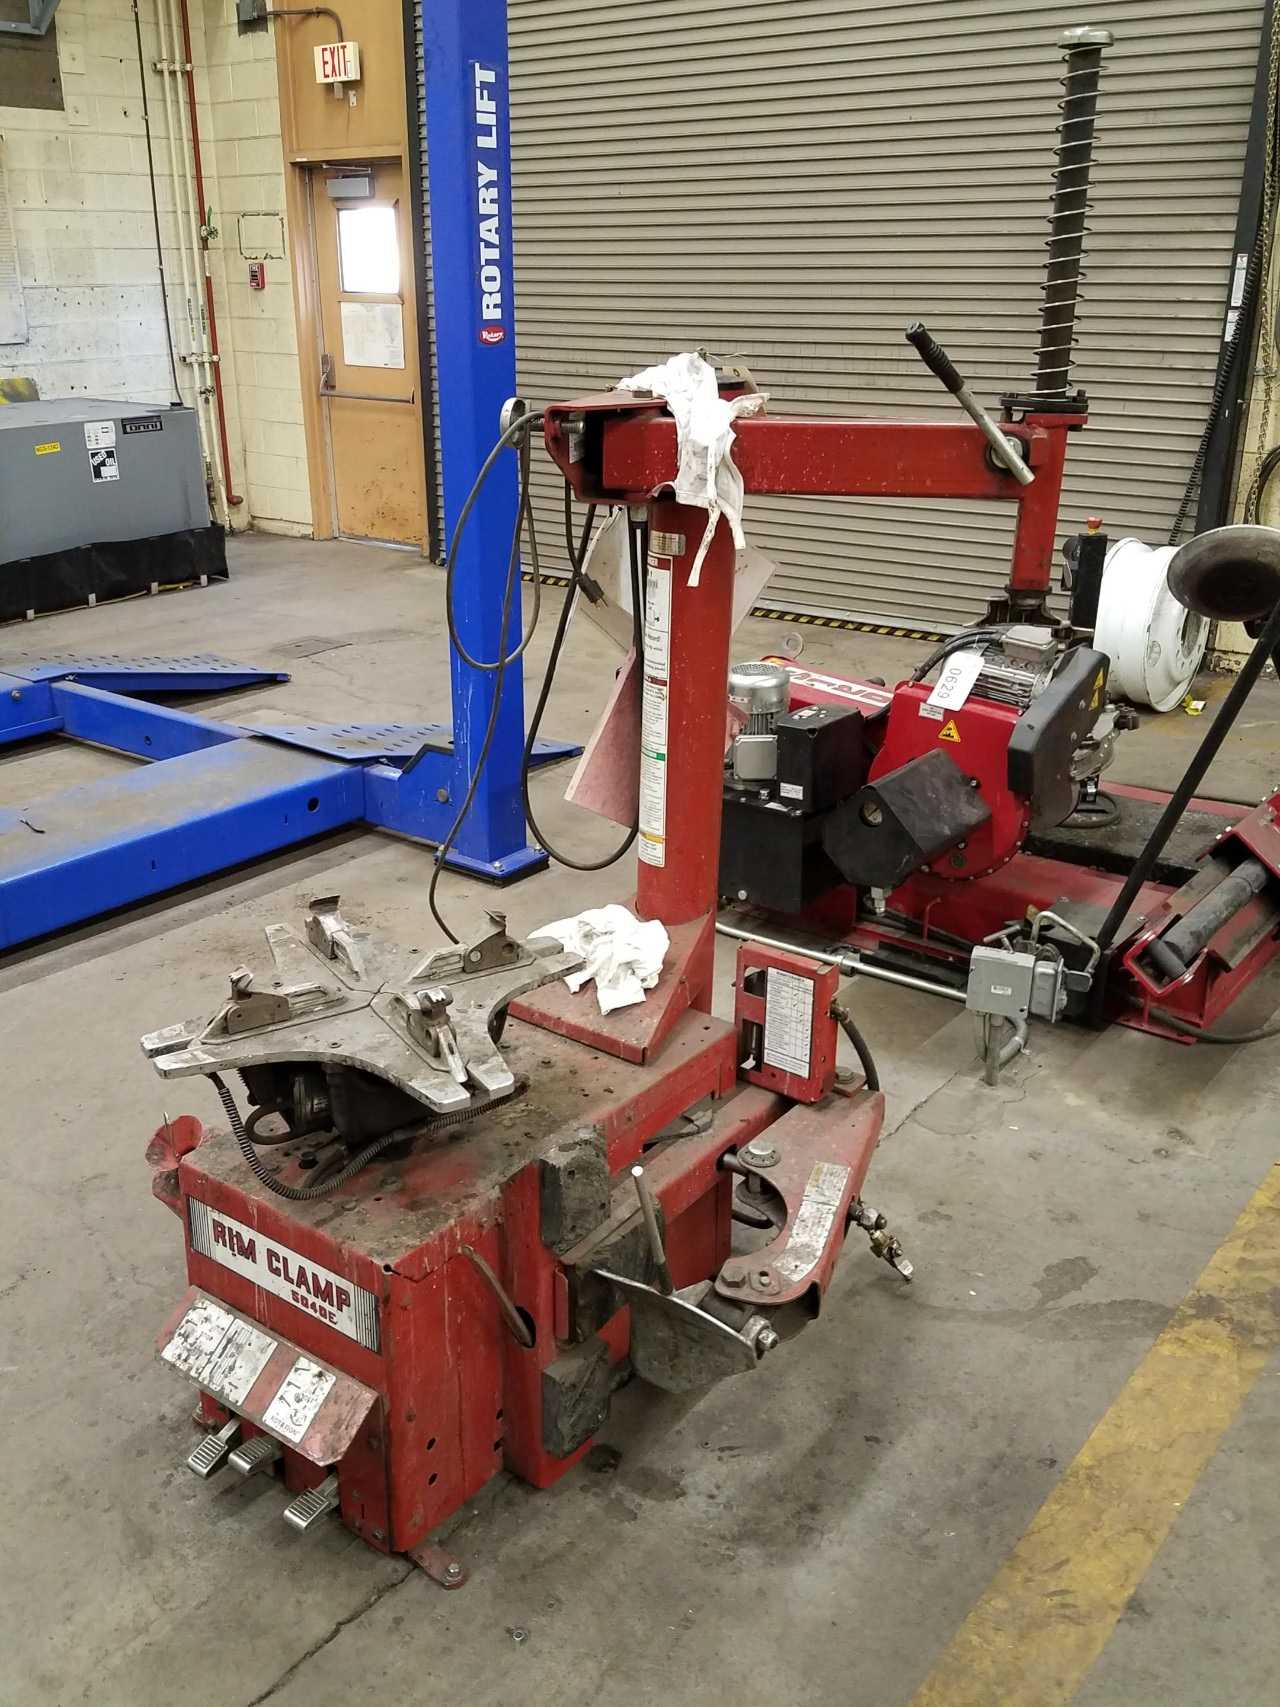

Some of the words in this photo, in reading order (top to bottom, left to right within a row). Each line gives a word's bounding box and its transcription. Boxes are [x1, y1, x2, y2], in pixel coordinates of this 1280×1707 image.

[321, 44, 347, 79] EXIT
[474, 62, 498, 149] LIFT
[478, 160, 502, 320] ROTARY
[90, 450, 107, 466] USED
[105, 457, 117, 466] OIL
[936, 667, 963, 700] 0629
[212, 1218, 257, 1264] RIM
[266, 1247, 351, 1313] CLAMP
